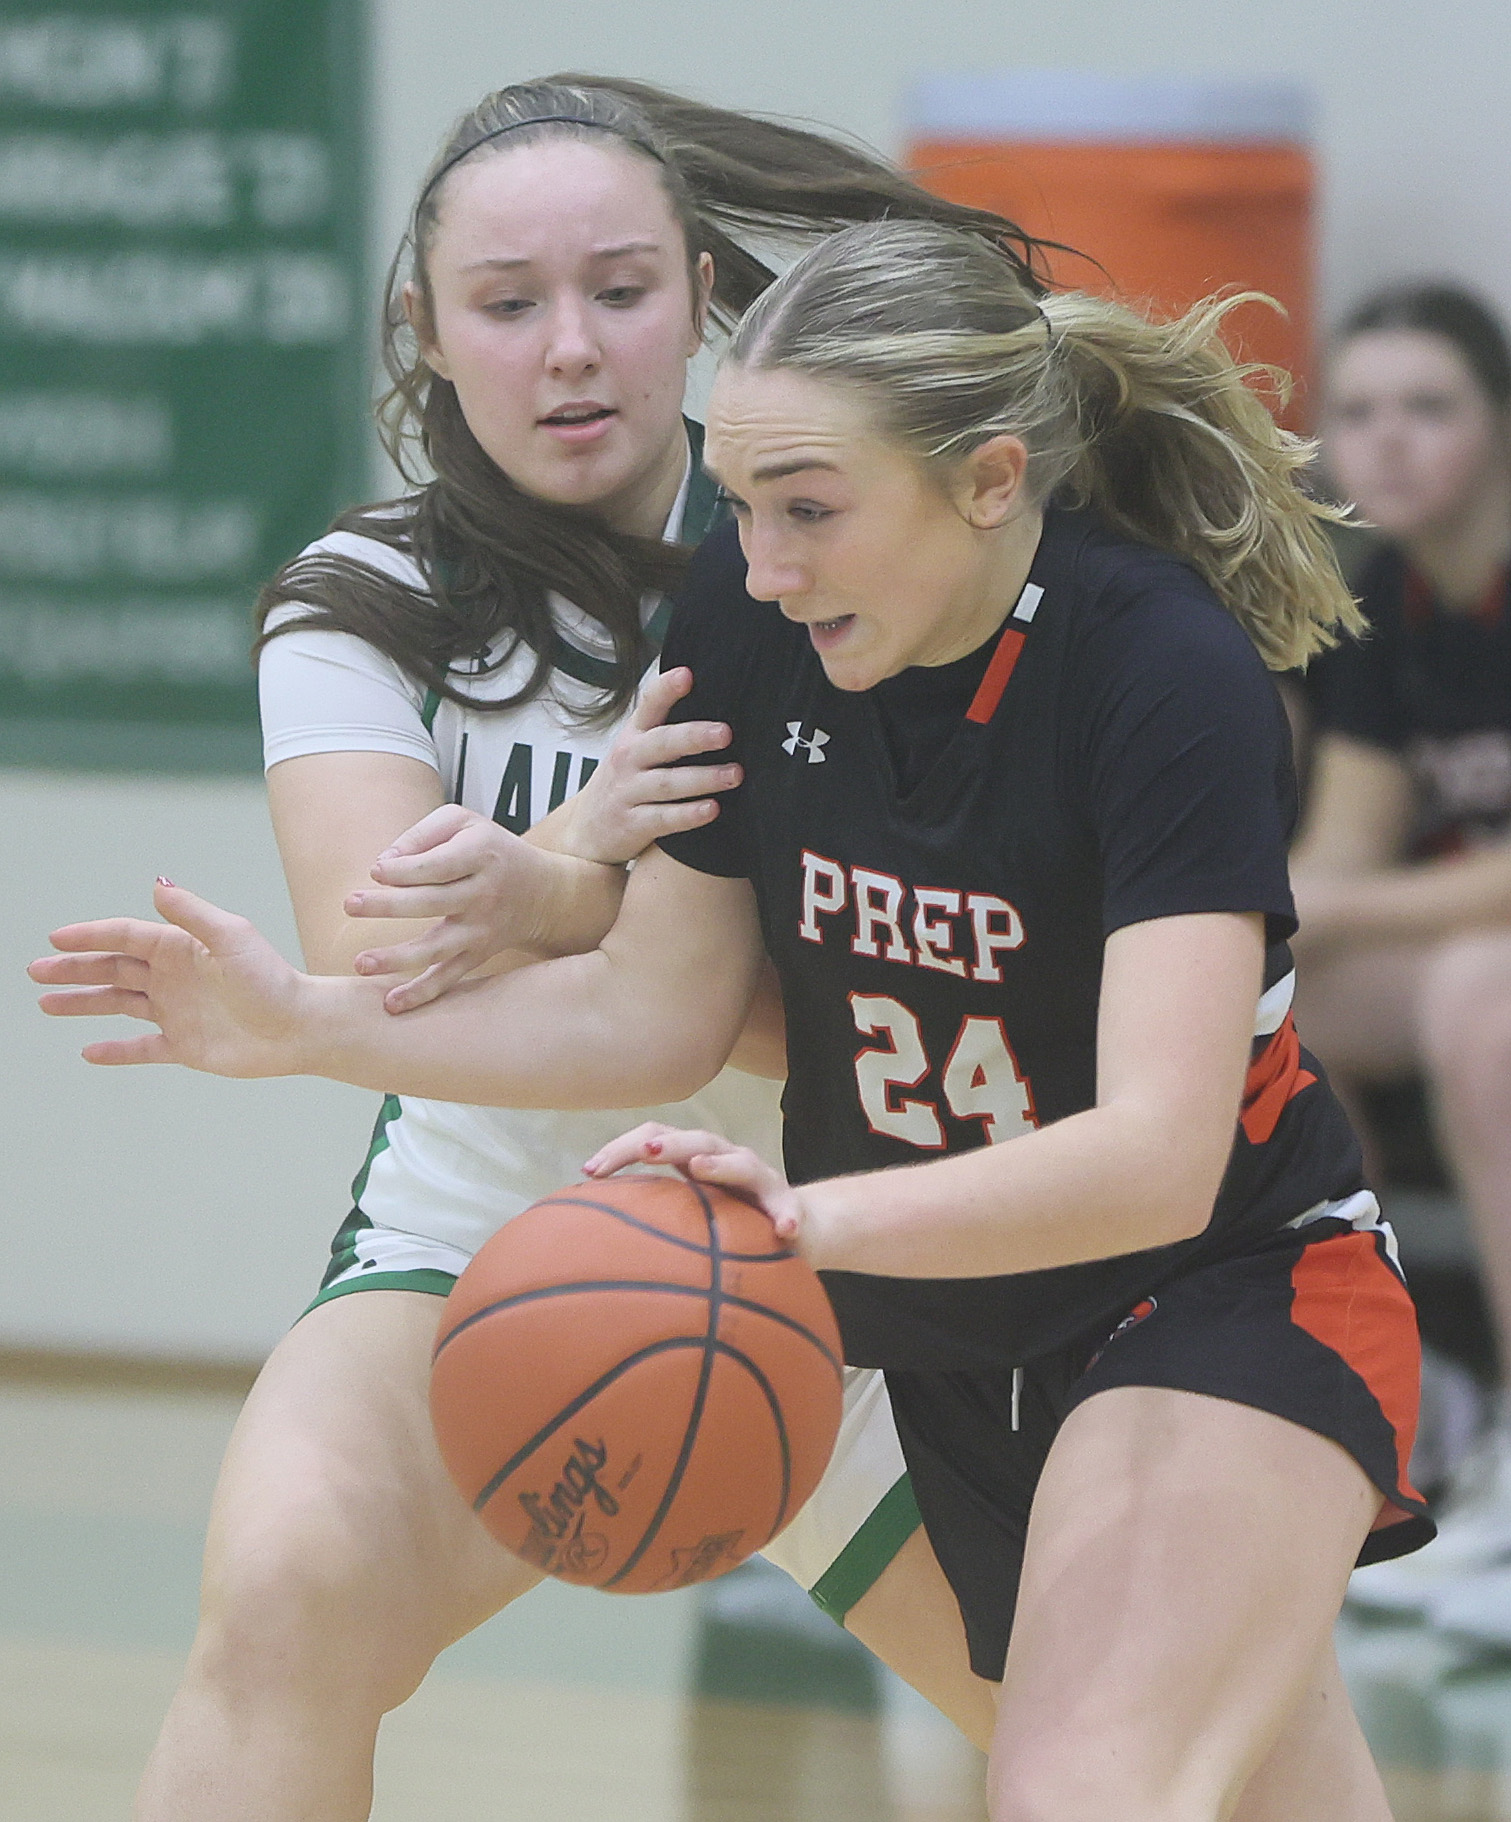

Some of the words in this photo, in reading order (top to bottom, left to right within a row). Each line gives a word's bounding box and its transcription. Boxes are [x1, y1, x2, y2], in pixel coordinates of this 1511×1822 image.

[798, 848, 1028, 983] PREP
[847, 990, 1040, 1149] 24
[516, 1437, 620, 1558] lings
